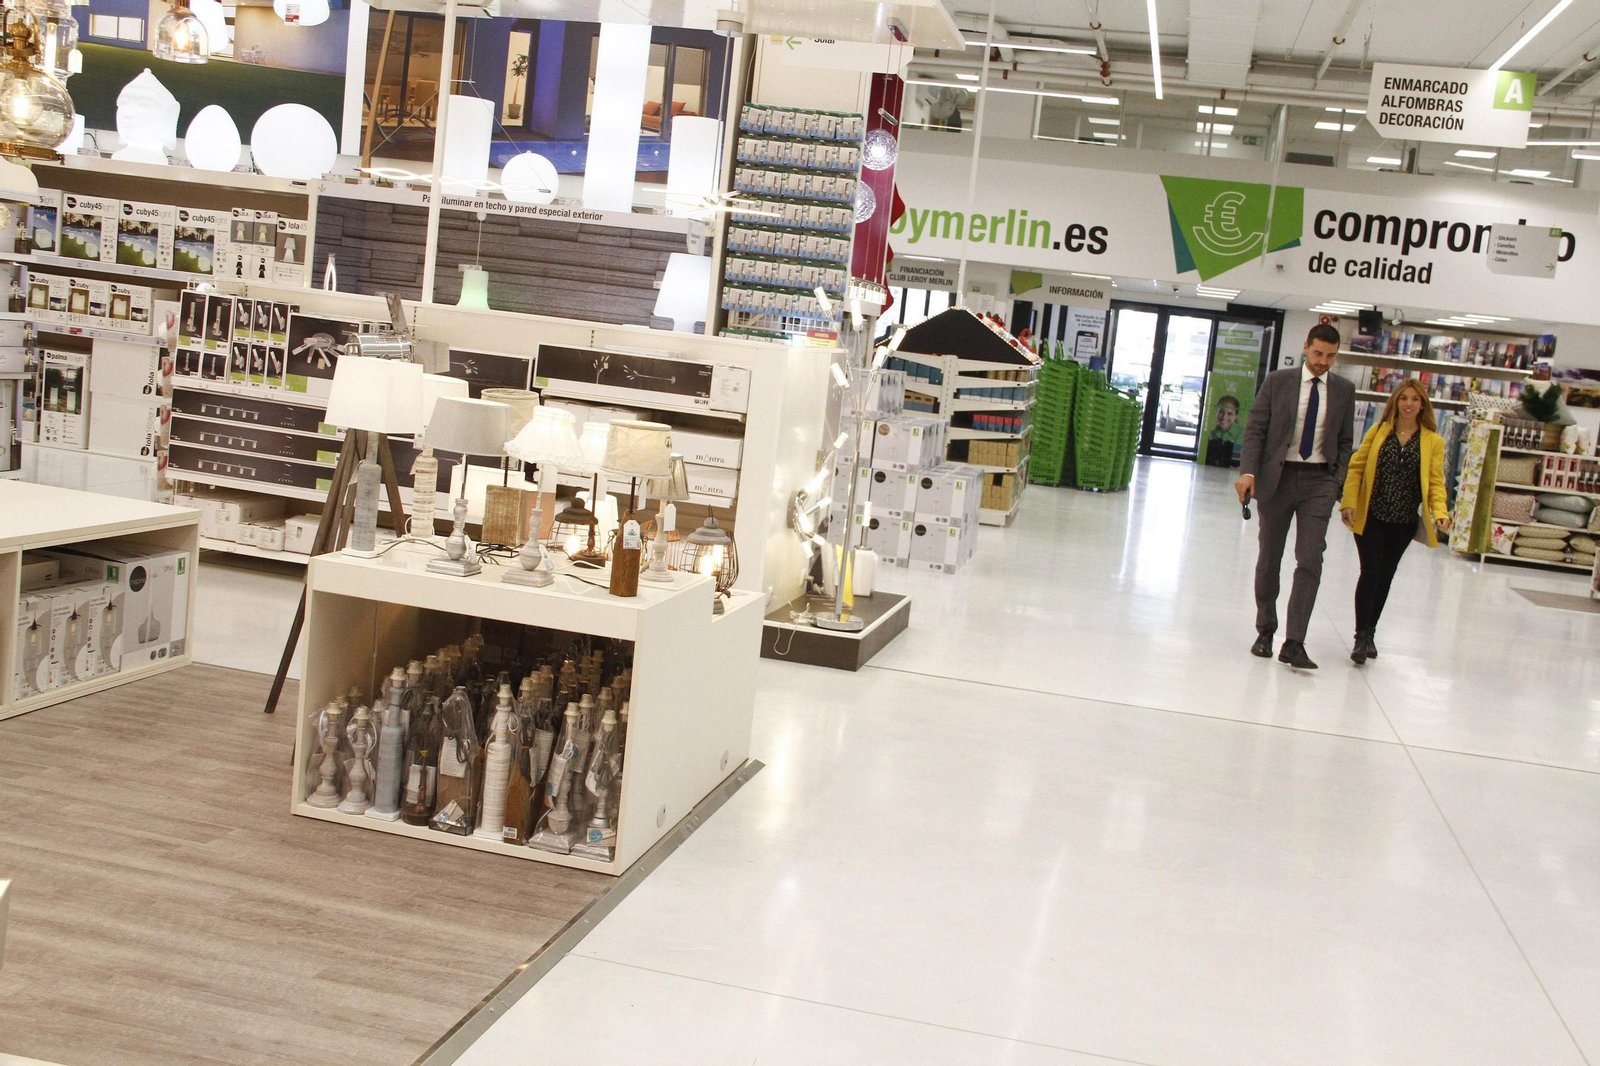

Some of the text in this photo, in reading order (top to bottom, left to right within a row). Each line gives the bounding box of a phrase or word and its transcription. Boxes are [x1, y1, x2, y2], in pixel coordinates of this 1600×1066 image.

[1383, 77, 1469, 95] ENMARCADO
[1503, 79, 1524, 105] A
[1380, 95, 1464, 113] ALFOMBRAS
[1378, 112, 1465, 131] DECORACIÓN
[441, 195, 473, 208] iluminar
[474, 201, 484, 209] en
[485, 200, 507, 211] techo
[508, 204, 514, 213] y
[514, 205, 537, 216] pared
[538, 207, 571, 218] especial
[572, 211, 603, 221] exterior
[900, 265, 945, 277] FINANCIACIÓN
[1308, 251, 1433, 285] de calidad
[889, 273, 953, 286] CLUB LEROY MERLIN
[1049, 285, 1104, 300] INFORMACIÓN
[51, 353, 67, 361] palma
